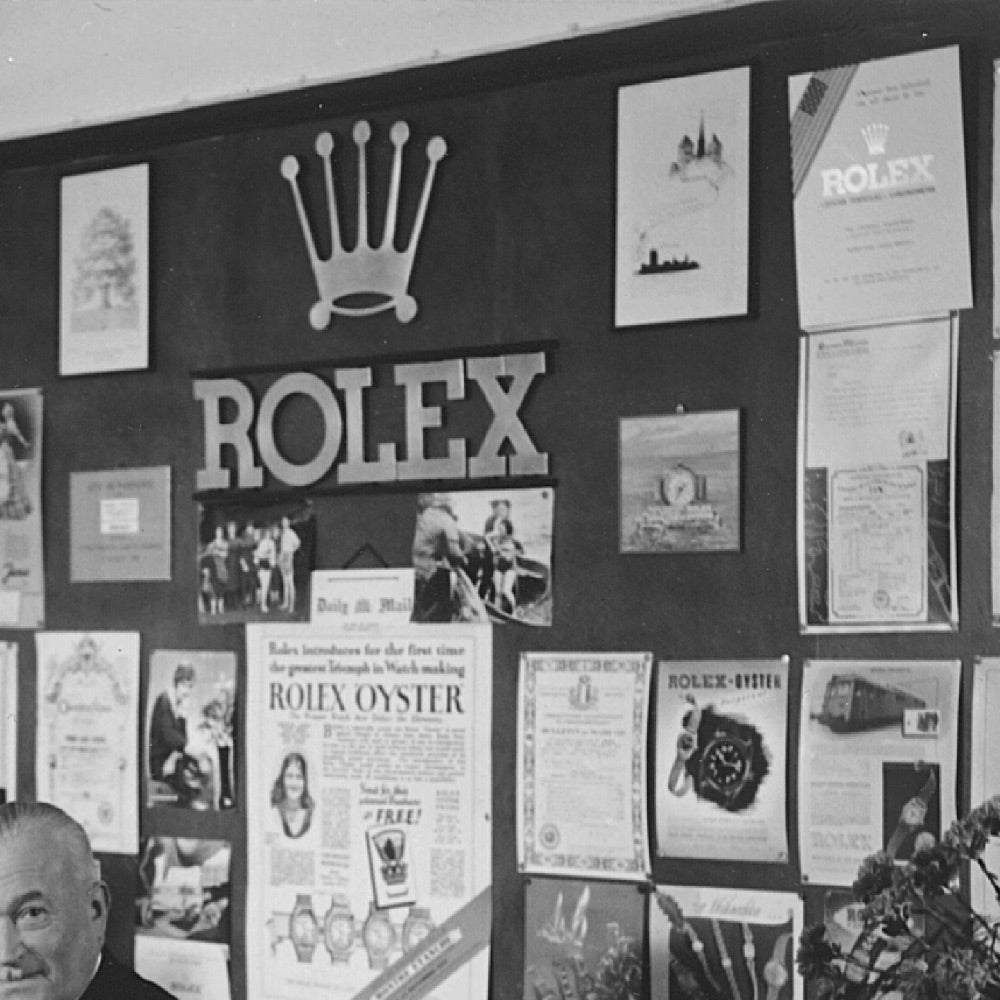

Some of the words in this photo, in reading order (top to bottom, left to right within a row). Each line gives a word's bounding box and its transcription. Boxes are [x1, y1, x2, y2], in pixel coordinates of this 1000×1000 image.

[820, 154, 935, 198] ROLEX
[192, 351, 549, 489] ROLEX
[364, 643, 381, 656] for
[384, 643, 404, 656] the
[408, 643, 432, 656] first
[436, 643, 465, 656] time
[373, 660, 384, 674] in
[269, 682, 346, 712] ROLEX
[355, 682, 465, 714] OYSTER
[376, 808, 422, 825] FREE!
